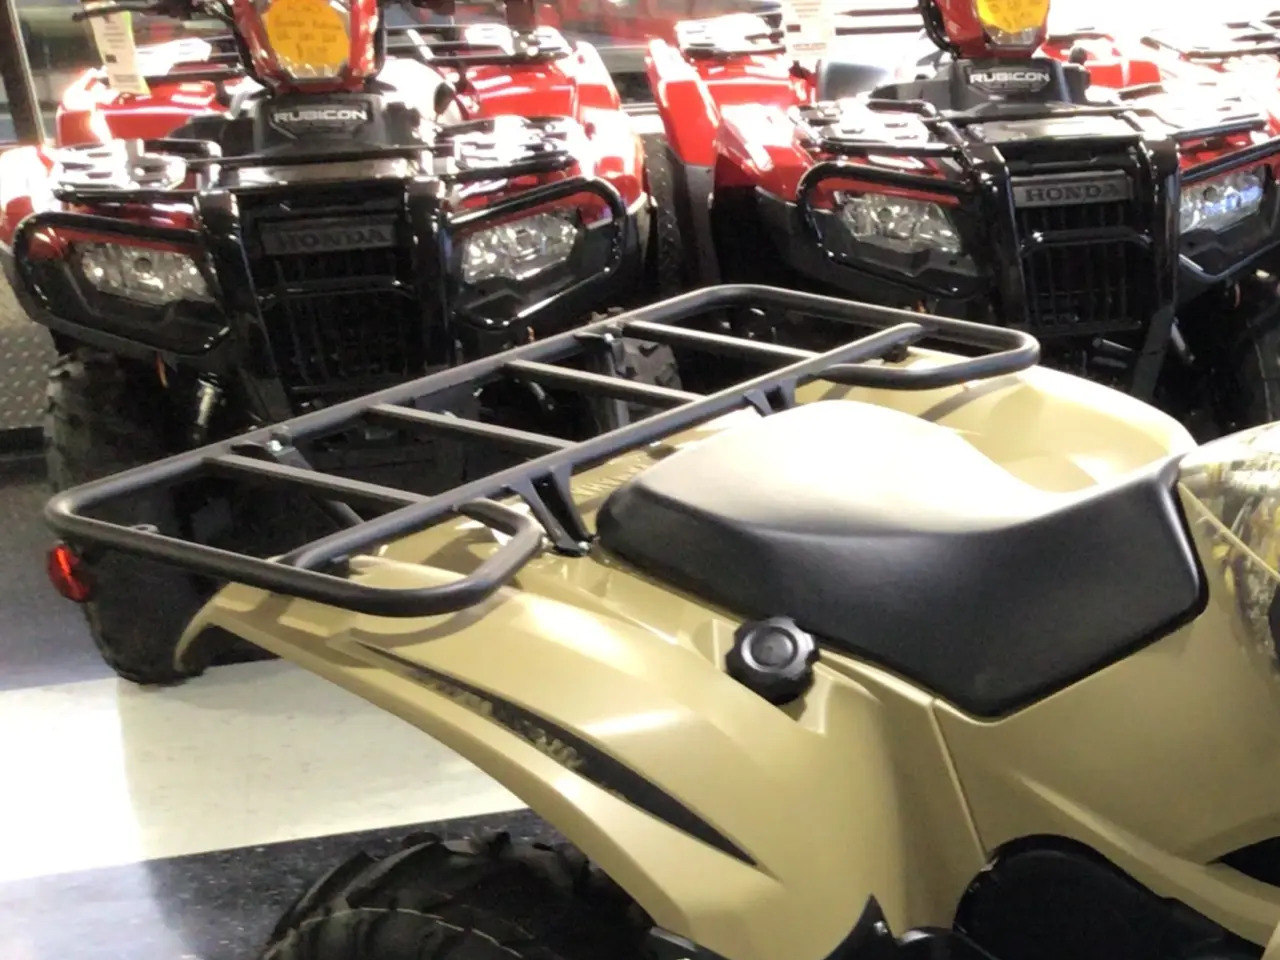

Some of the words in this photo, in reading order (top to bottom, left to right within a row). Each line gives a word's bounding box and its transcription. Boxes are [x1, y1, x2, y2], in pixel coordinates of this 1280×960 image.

[969, 72, 1051, 83] RUBICON
[273, 110, 368, 122] RUBICON
[1025, 183, 1121, 202] HONDA
[279, 228, 391, 250] HONDA
